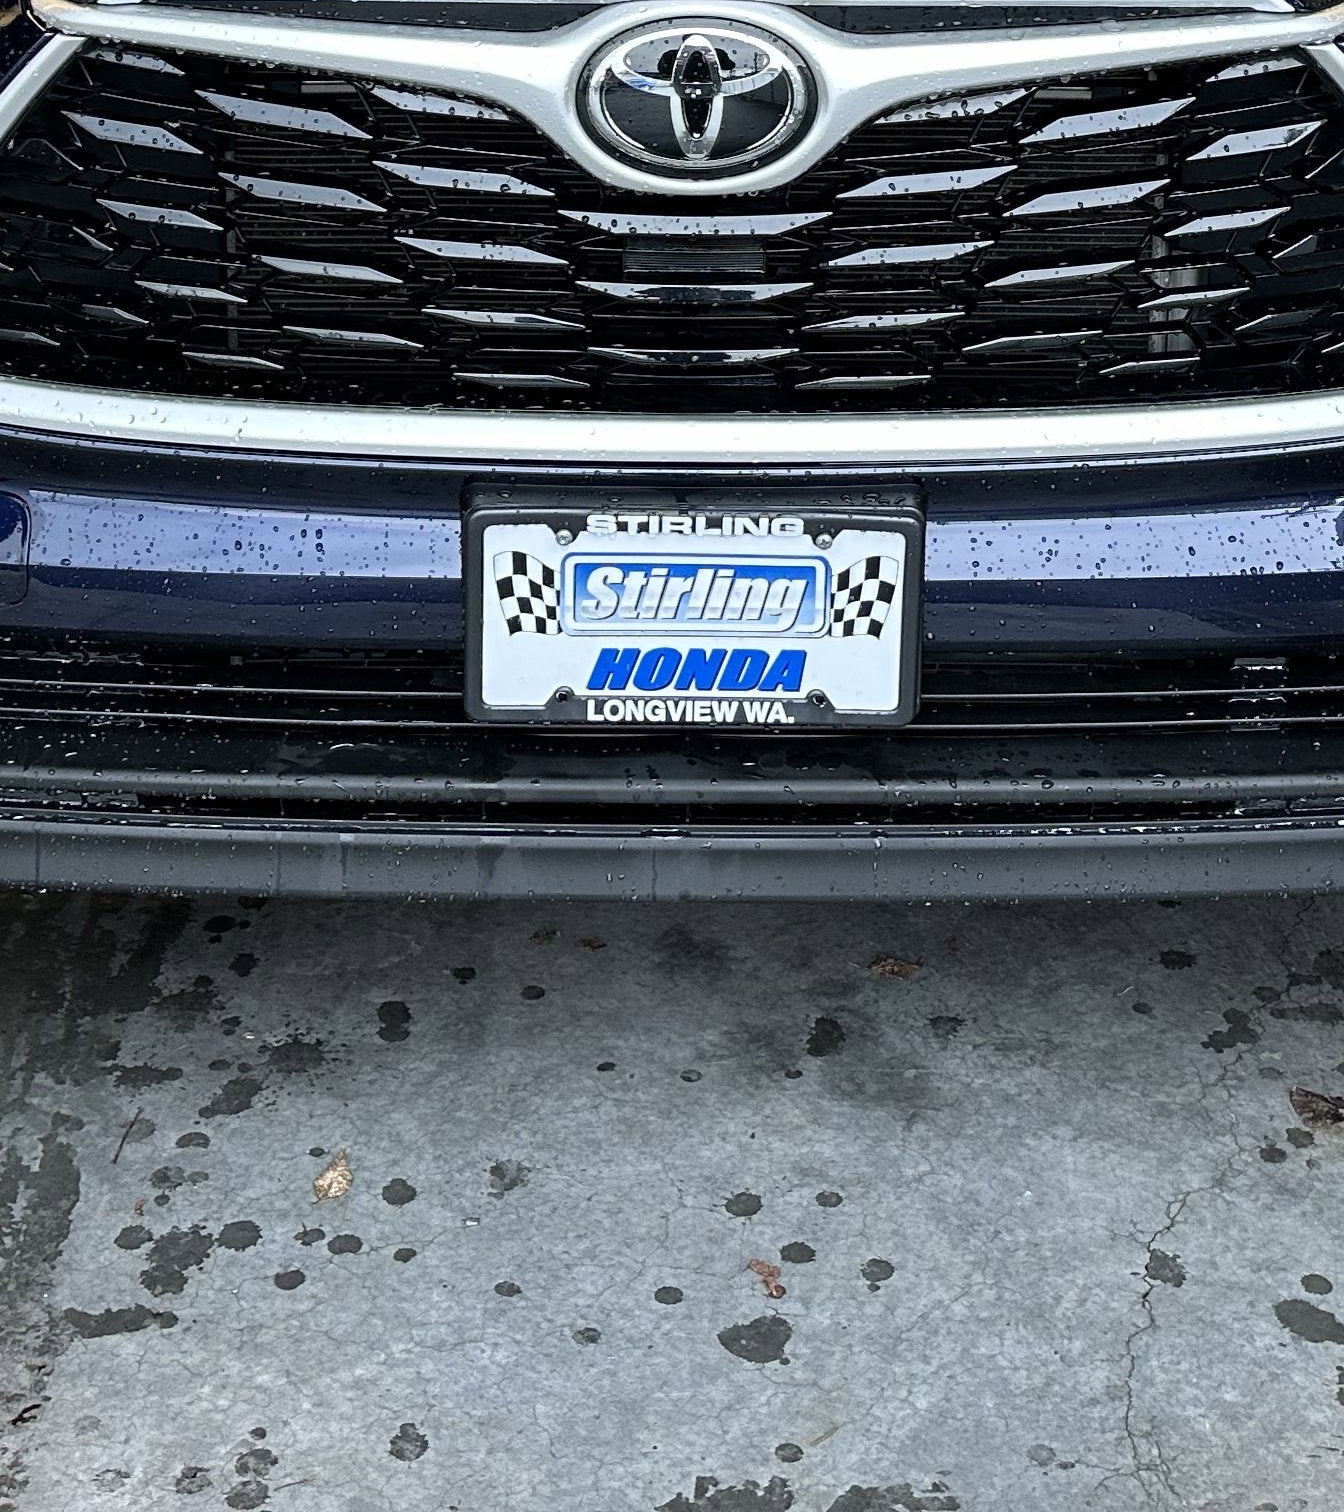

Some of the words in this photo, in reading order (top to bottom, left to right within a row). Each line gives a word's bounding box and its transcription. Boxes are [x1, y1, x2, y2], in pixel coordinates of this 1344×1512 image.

[586, 515, 805, 536] STIRLING
[581, 566, 809, 632] Stirling
[587, 647, 807, 692] HONDA
[587, 699, 738, 722] LONGVIEW
[740, 701, 795, 723] WA.
